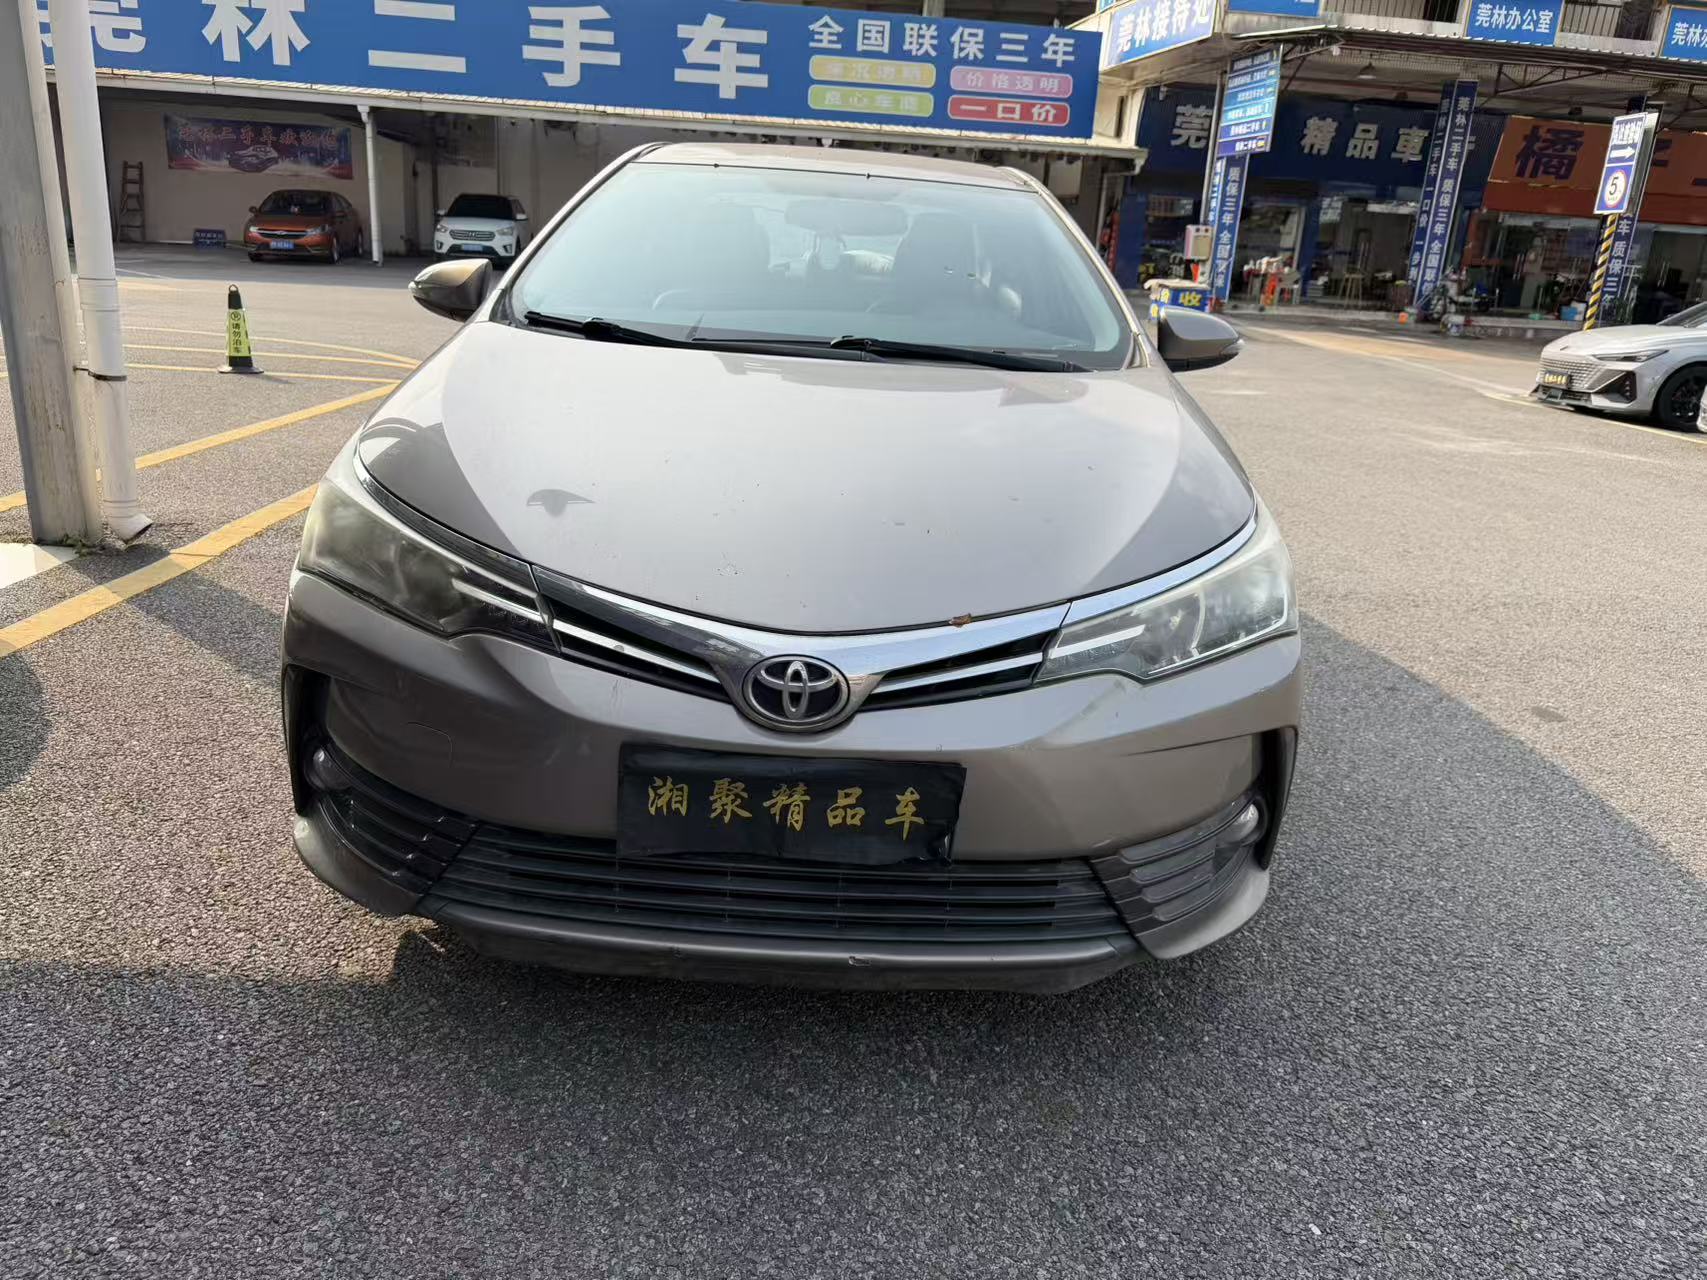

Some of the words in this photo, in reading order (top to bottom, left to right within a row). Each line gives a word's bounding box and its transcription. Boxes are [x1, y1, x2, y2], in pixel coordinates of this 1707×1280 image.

[1474, 4, 1553, 33] 莞林办公室
[808, 15, 1075, 67] 全国联保三年
[967, 72, 1061, 93] 价格透明
[960, 102, 1057, 122] 一口价
[1446, 96, 1471, 171] 莞林二手车
[1609, 176, 1620, 196] 5
[648, 775, 925, 841] 湘聚精品车
